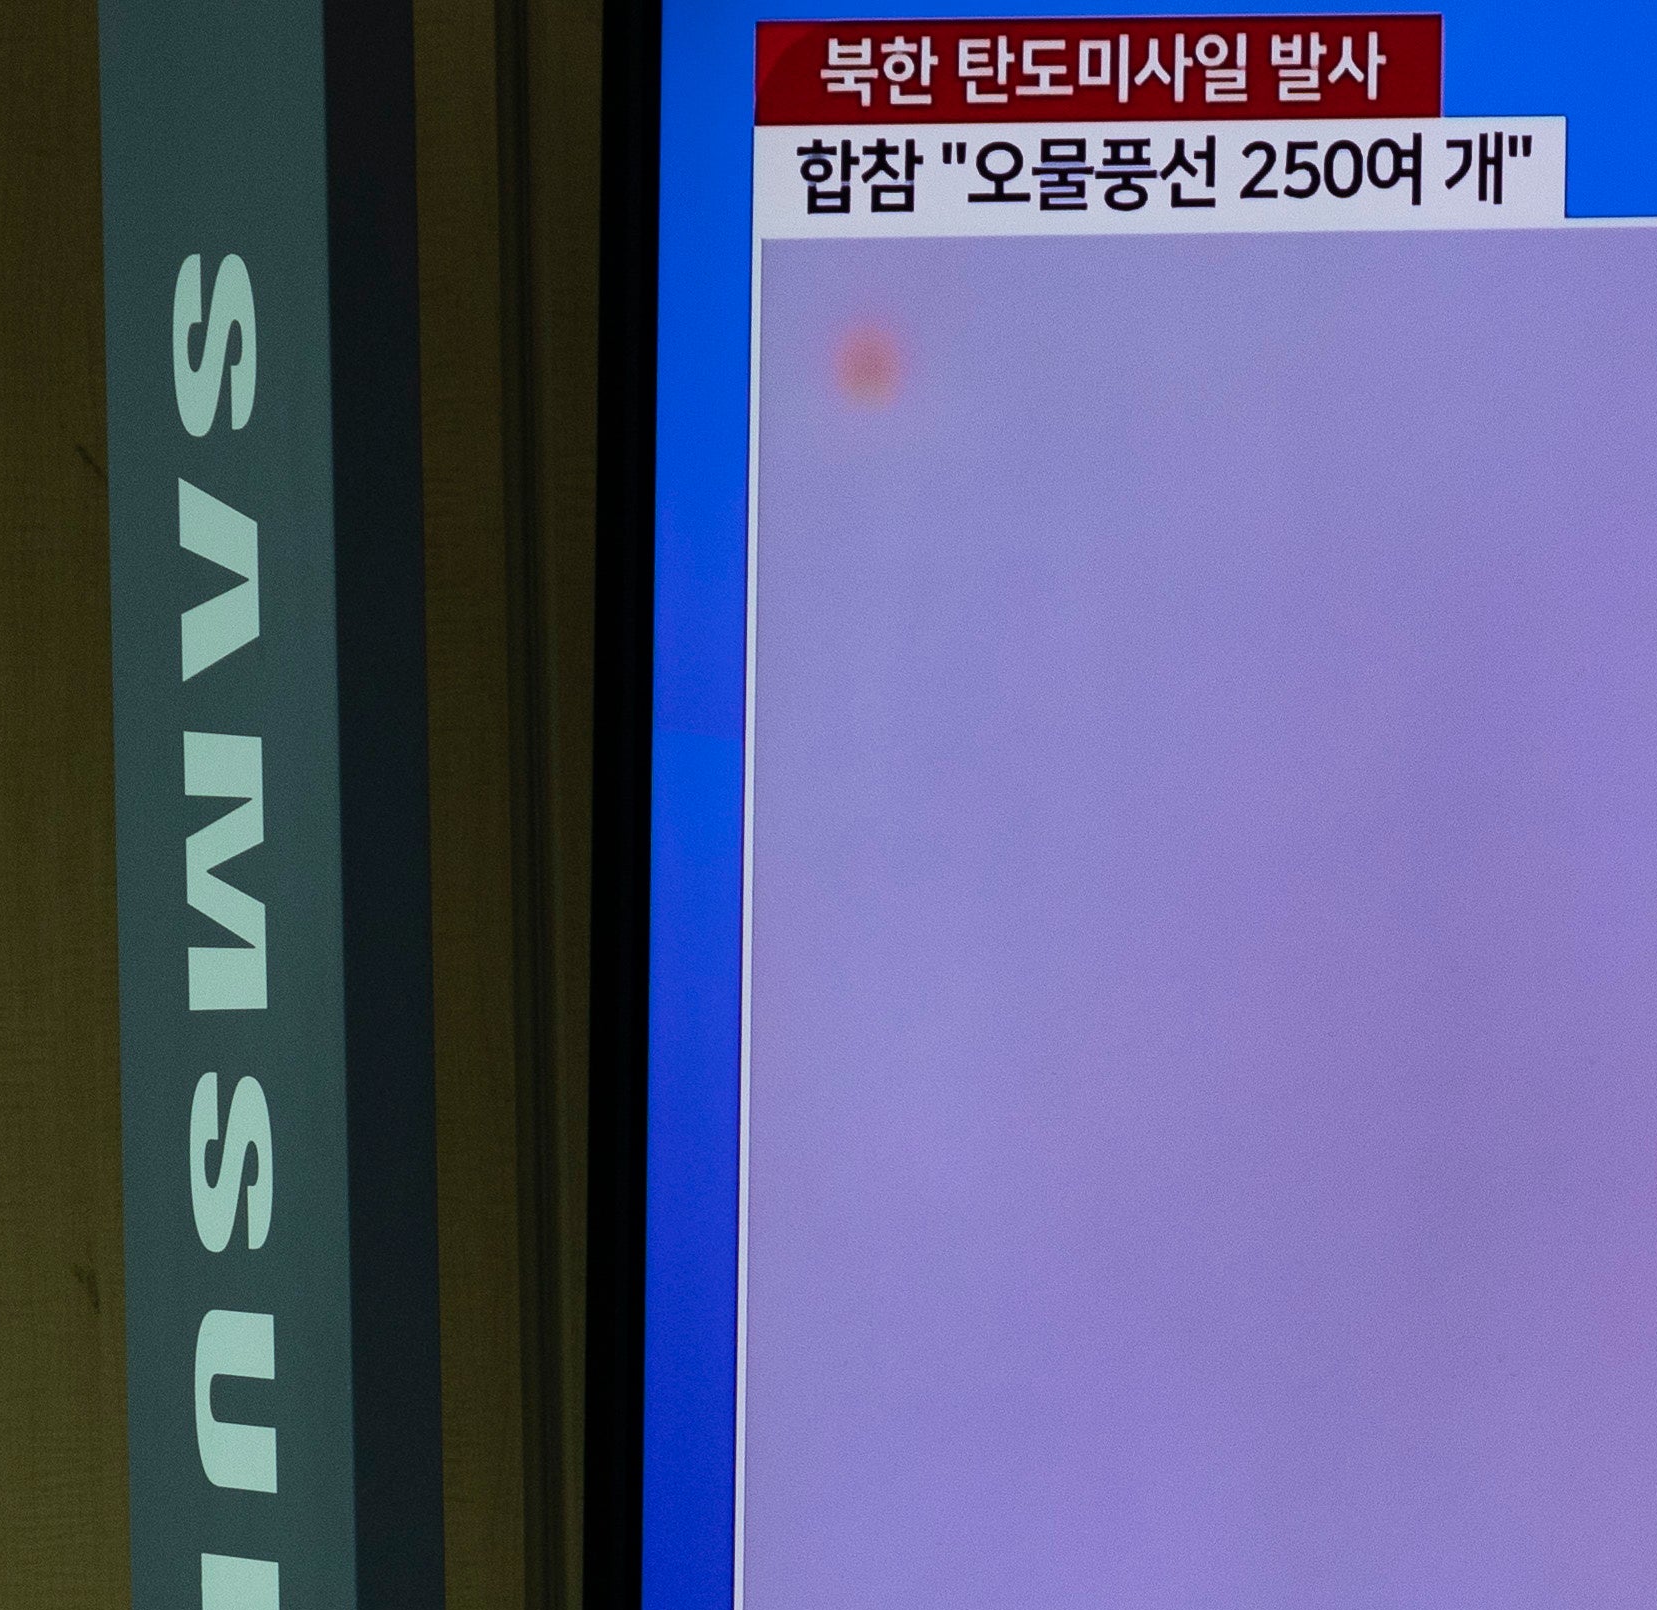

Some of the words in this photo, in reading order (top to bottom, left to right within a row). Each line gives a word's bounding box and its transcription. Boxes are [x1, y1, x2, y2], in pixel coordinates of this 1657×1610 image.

[821, 36, 939, 106] 북한
[958, 33, 1248, 103] 탄도미사일
[1270, 32, 1387, 101] 발사
[797, 139, 924, 214] 합참
[942, 136, 1216, 211] "오물풍선
[1240, 133, 1422, 206] 250여
[1445, 132, 1533, 205] 개"
